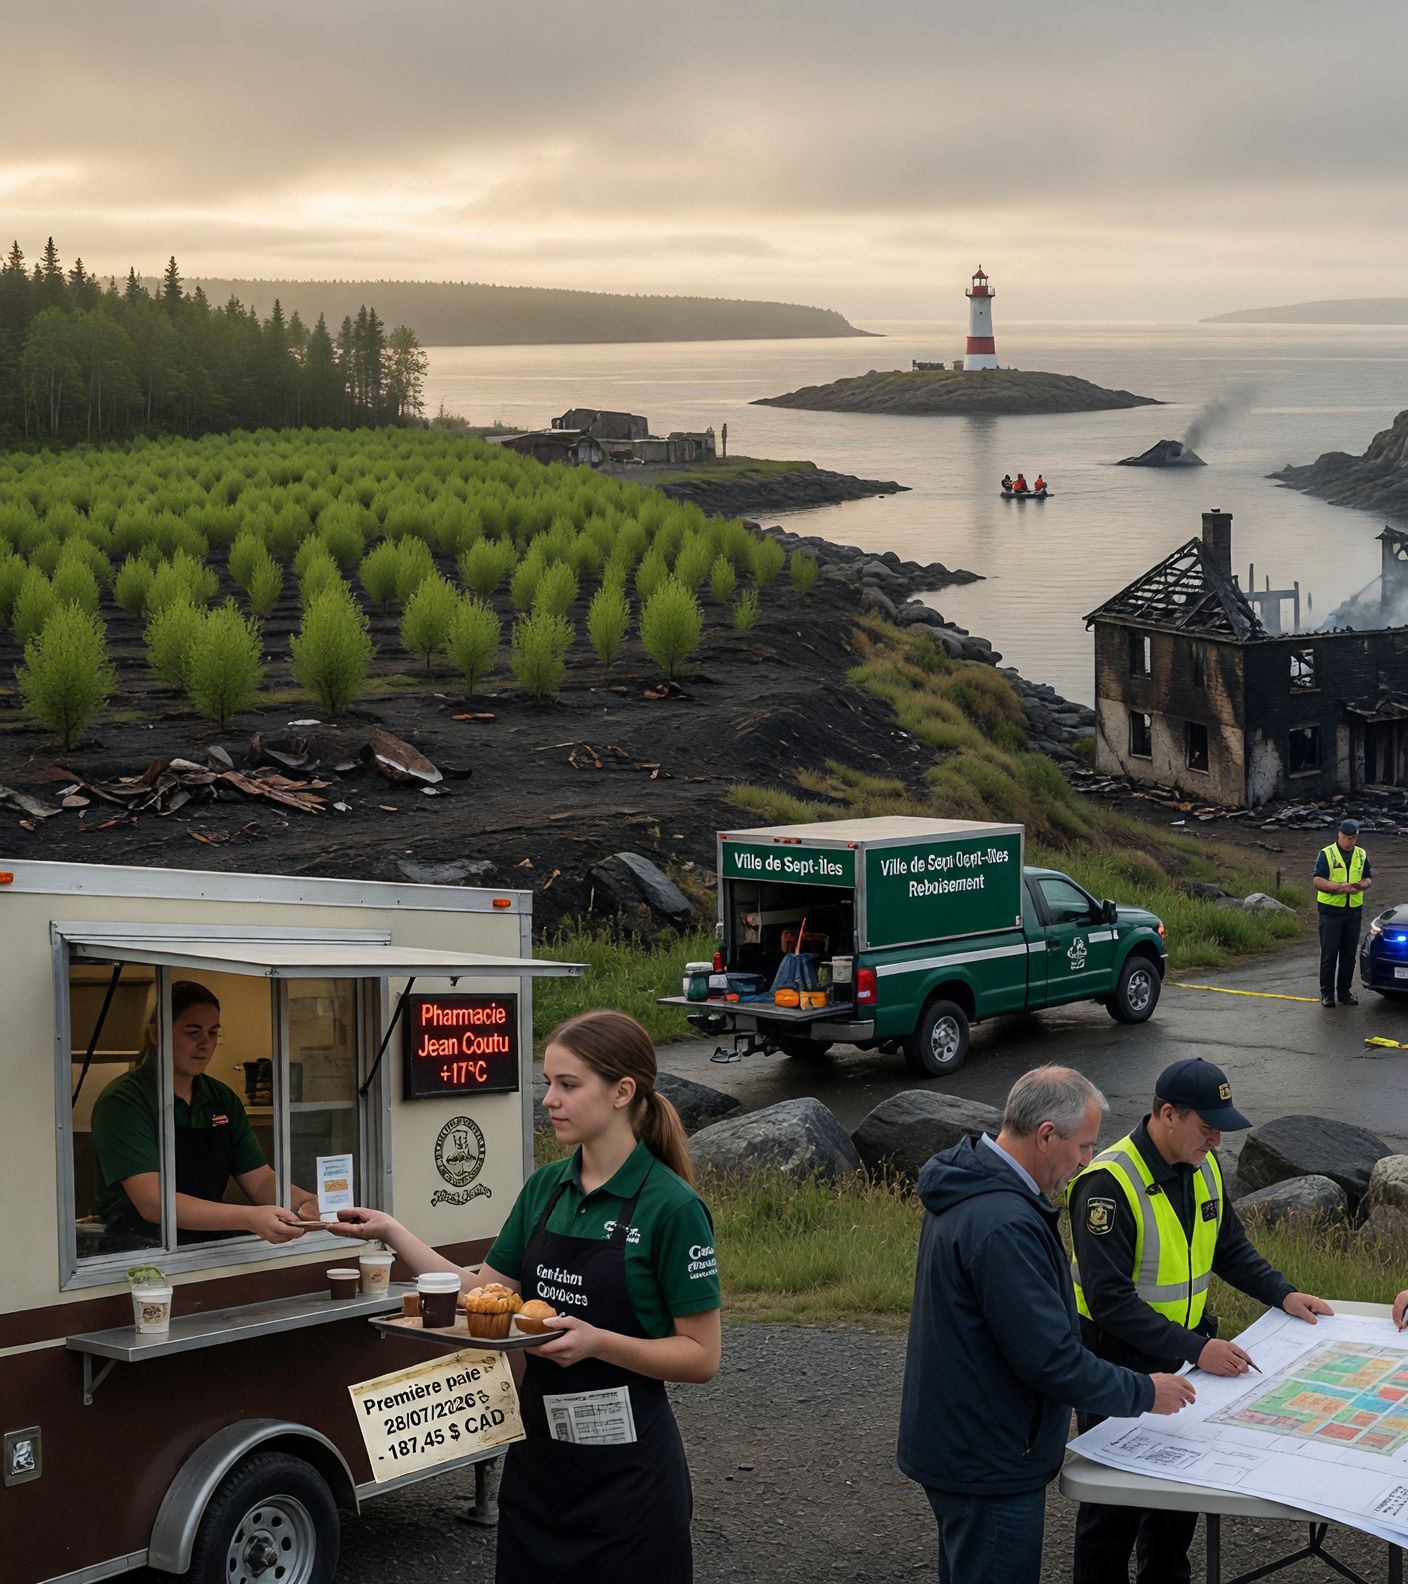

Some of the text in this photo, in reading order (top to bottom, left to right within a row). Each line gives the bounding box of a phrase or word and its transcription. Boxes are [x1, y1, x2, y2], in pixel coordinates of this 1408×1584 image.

[734, 852, 762, 870] Ville
[765, 854, 781, 871] de
[880, 858, 908, 876] Ville
[910, 855, 926, 873] de
[908, 874, 985, 898] Reboisement
[421, 1002, 506, 1026] Pharmacie
[418, 1031, 509, 1057] Jean Coutu
[363, 1367, 481, 1415] Première paie
[388, 1428, 445, 1460] 187,45
[448, 1422, 461, 1442] $
[464, 1408, 505, 1434] CAD
